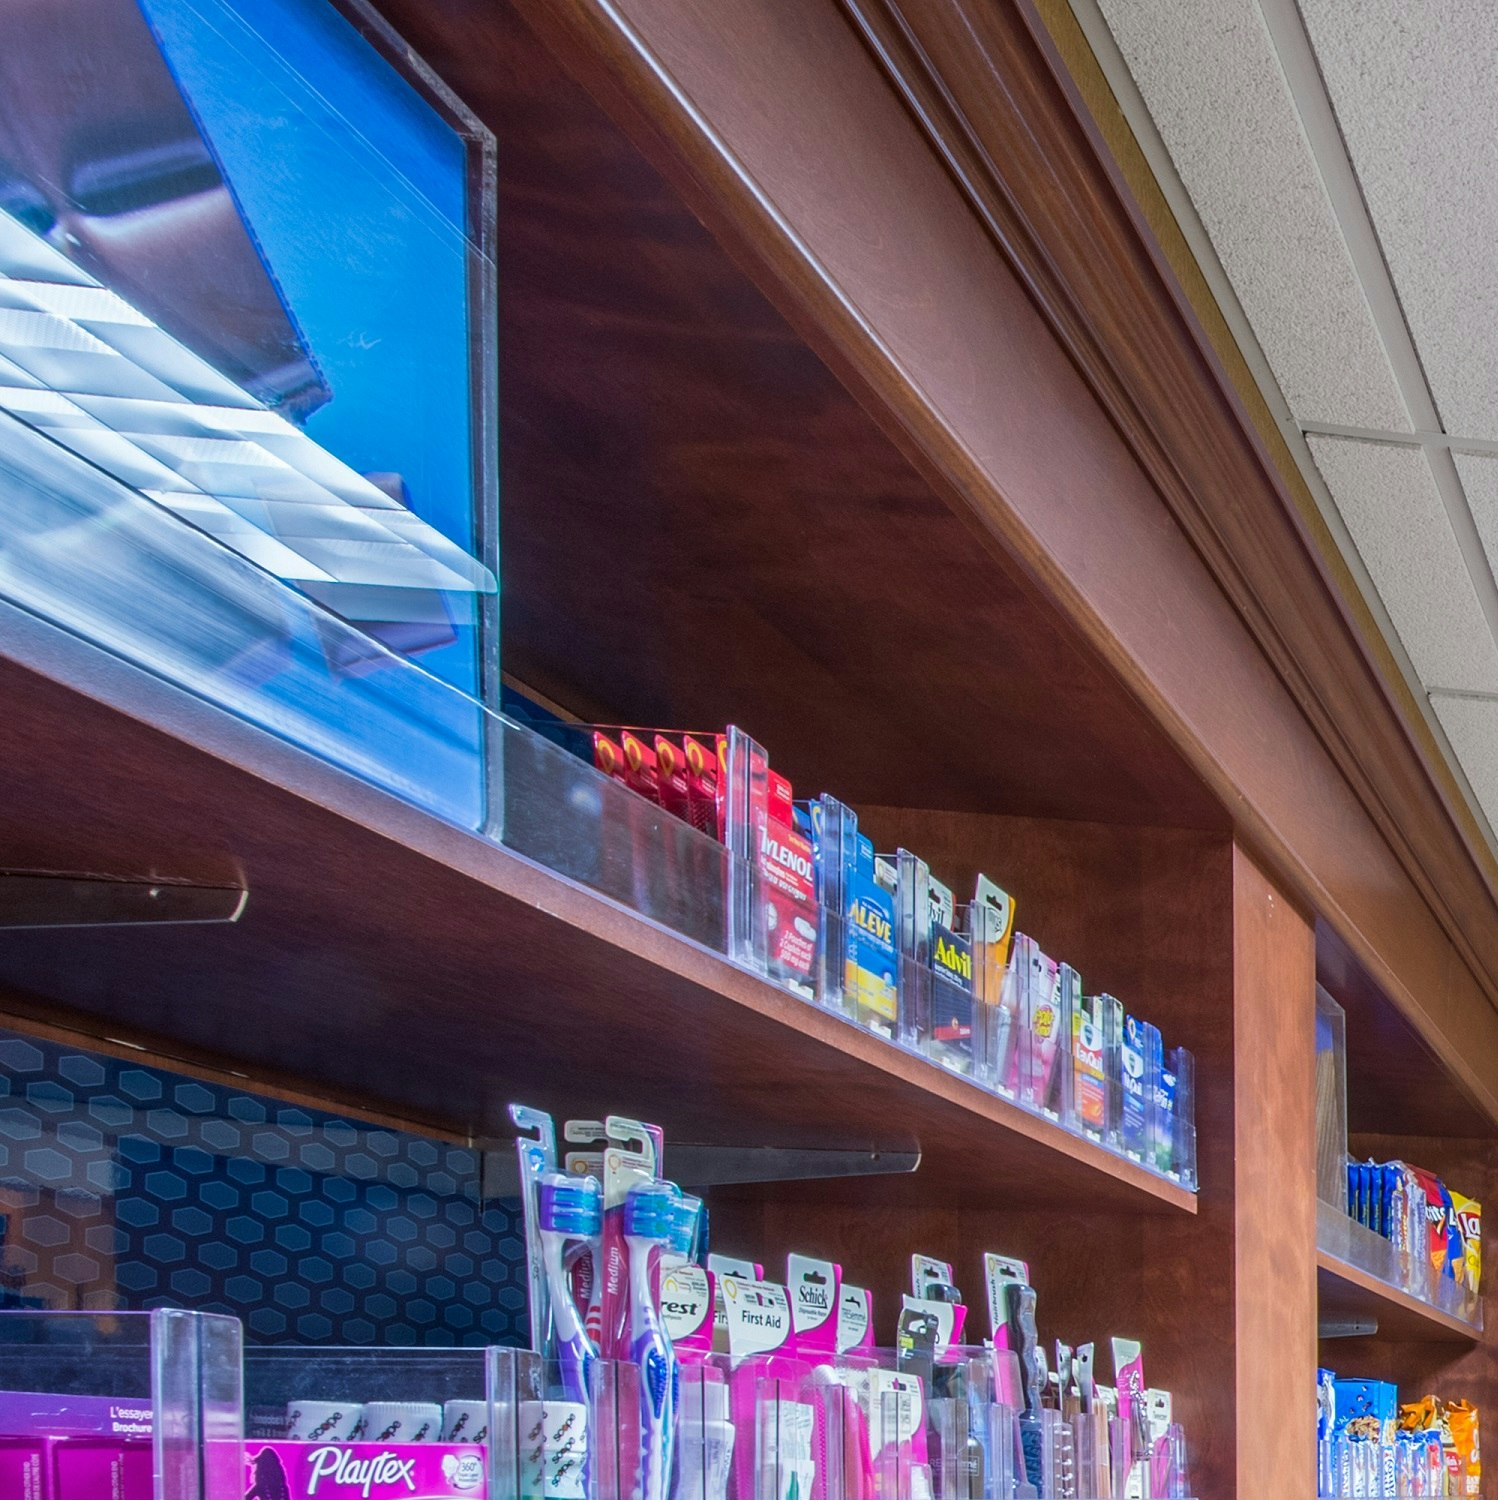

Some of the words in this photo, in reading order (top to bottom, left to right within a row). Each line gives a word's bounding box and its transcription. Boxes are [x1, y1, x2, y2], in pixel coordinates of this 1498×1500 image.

[759, 826, 813, 881] TYLENOL
[849, 898, 892, 944] ALEVE
[934, 936, 971, 980] Advil
[607, 1247, 619, 1295] Medium
[799, 1285, 827, 1309] Schick
[742, 1310, 763, 1325] First
[765, 1313, 781, 1329] Aid
[308, 1412, 343, 1440] scope
[553, 1413, 575, 1442] scope
[552, 1437, 575, 1464] scope
[308, 1446, 415, 1498] Playtex
[552, 1459, 574, 1487] scope
